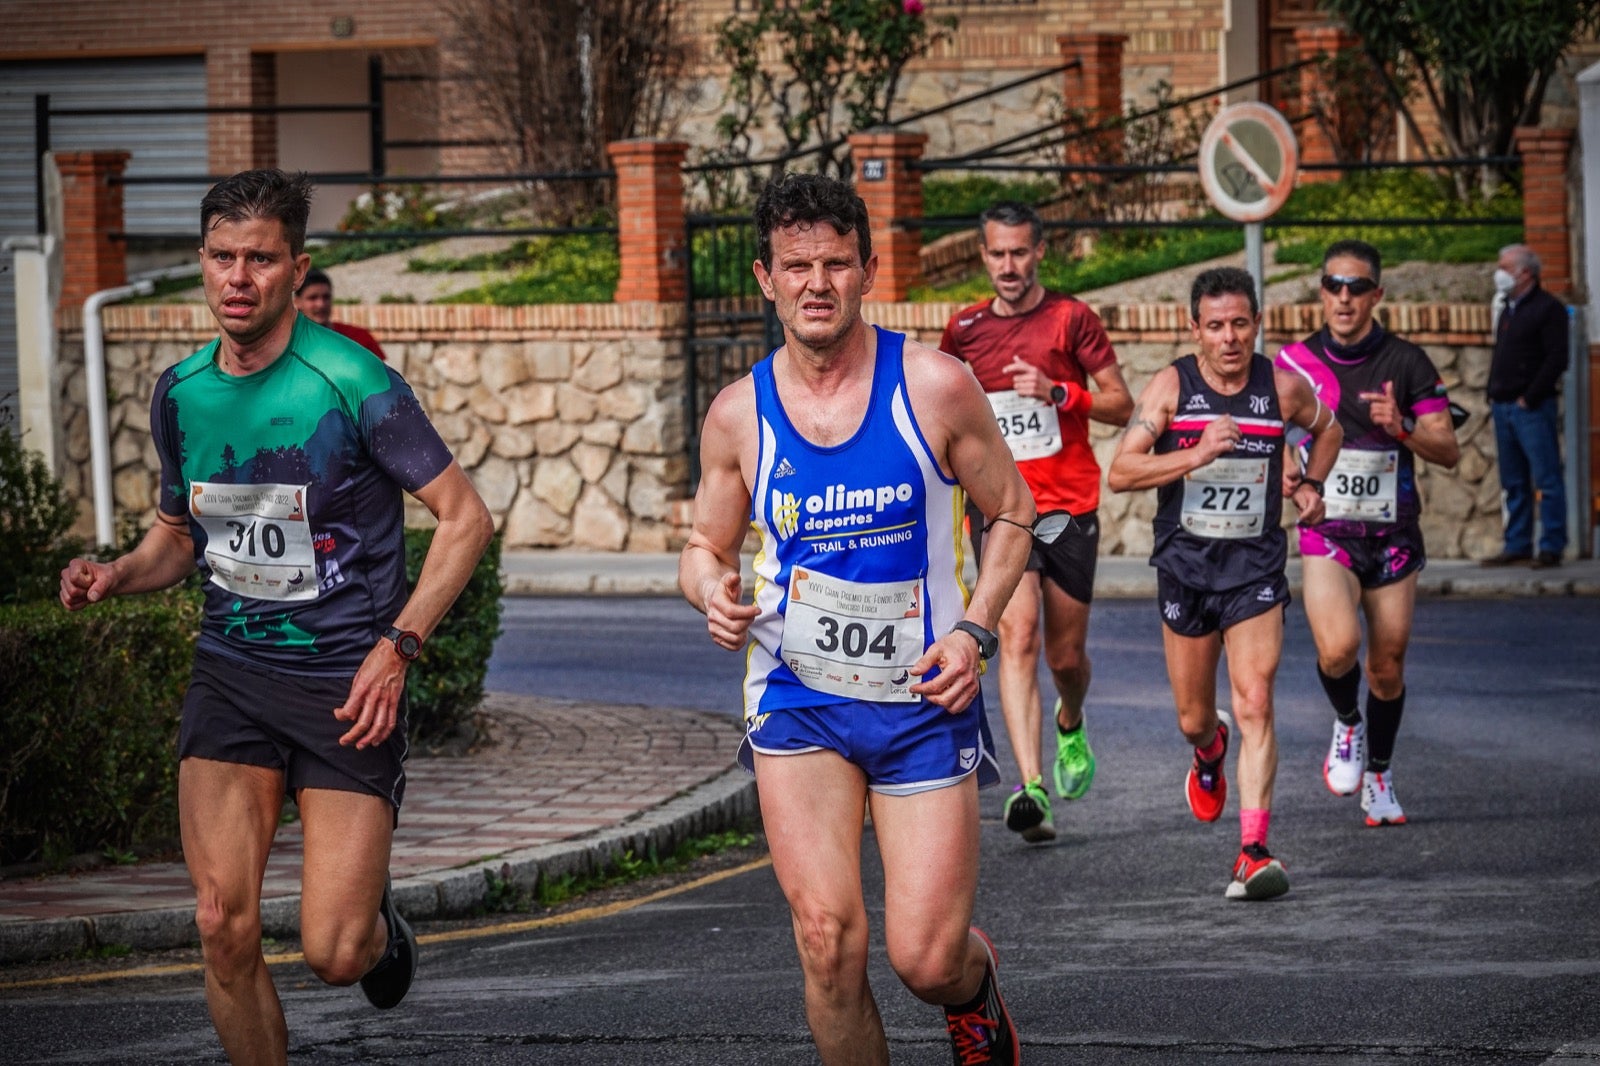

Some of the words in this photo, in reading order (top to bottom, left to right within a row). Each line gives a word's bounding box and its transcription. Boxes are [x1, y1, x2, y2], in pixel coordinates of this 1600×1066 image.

[1336, 474, 1380, 496] 380
[805, 483, 913, 514] olimpo
[1201, 486, 1251, 511] 272
[804, 513, 873, 532] deportes
[226, 520, 286, 558] 310
[811, 540, 846, 553] TRAIL
[848, 539, 858, 549] &
[860, 530, 913, 548] RUNNING
[893, 591, 908, 603] 2022
[815, 616, 897, 660] 304
